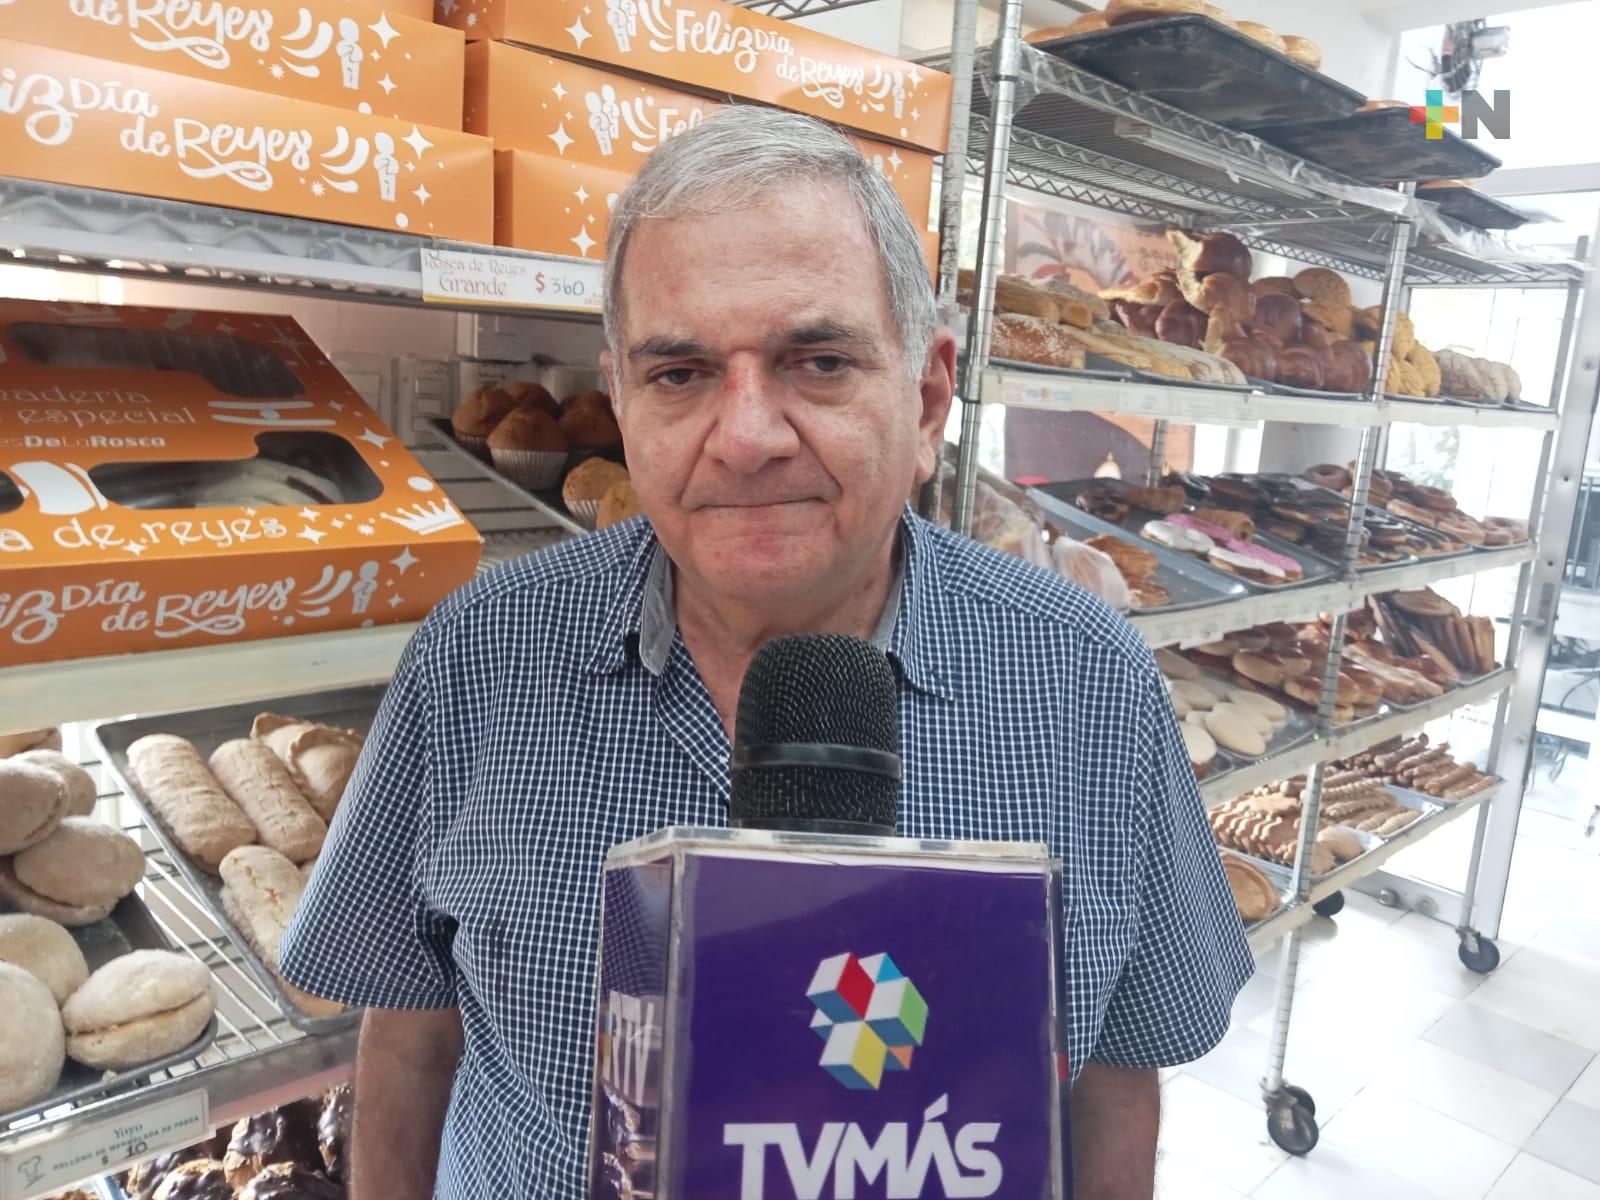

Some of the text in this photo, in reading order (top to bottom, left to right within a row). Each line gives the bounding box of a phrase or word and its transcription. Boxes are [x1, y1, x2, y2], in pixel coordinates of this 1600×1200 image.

[128, 0, 274, 69] Reyes
[676, 10, 794, 73] Feliz Día
[70, 77, 158, 117] Día
[776, 55, 865, 109] de Reyes
[120, 115, 312, 191] de Reyes
[439, 272, 509, 296] Grande
[469, 259, 483, 272] de
[489, 259, 527, 278] Reyes
[534, 271, 585, 296] $ 360
[18, 406, 196, 428] especial
[54, 517, 124, 549] de
[141, 518, 287, 547] reyes
[62, 579, 146, 610] Día
[102, 577, 296, 638] de Reyes
[125, 1141, 148, 1158] 10
[723, 1093, 1003, 1200] TVMÁS
